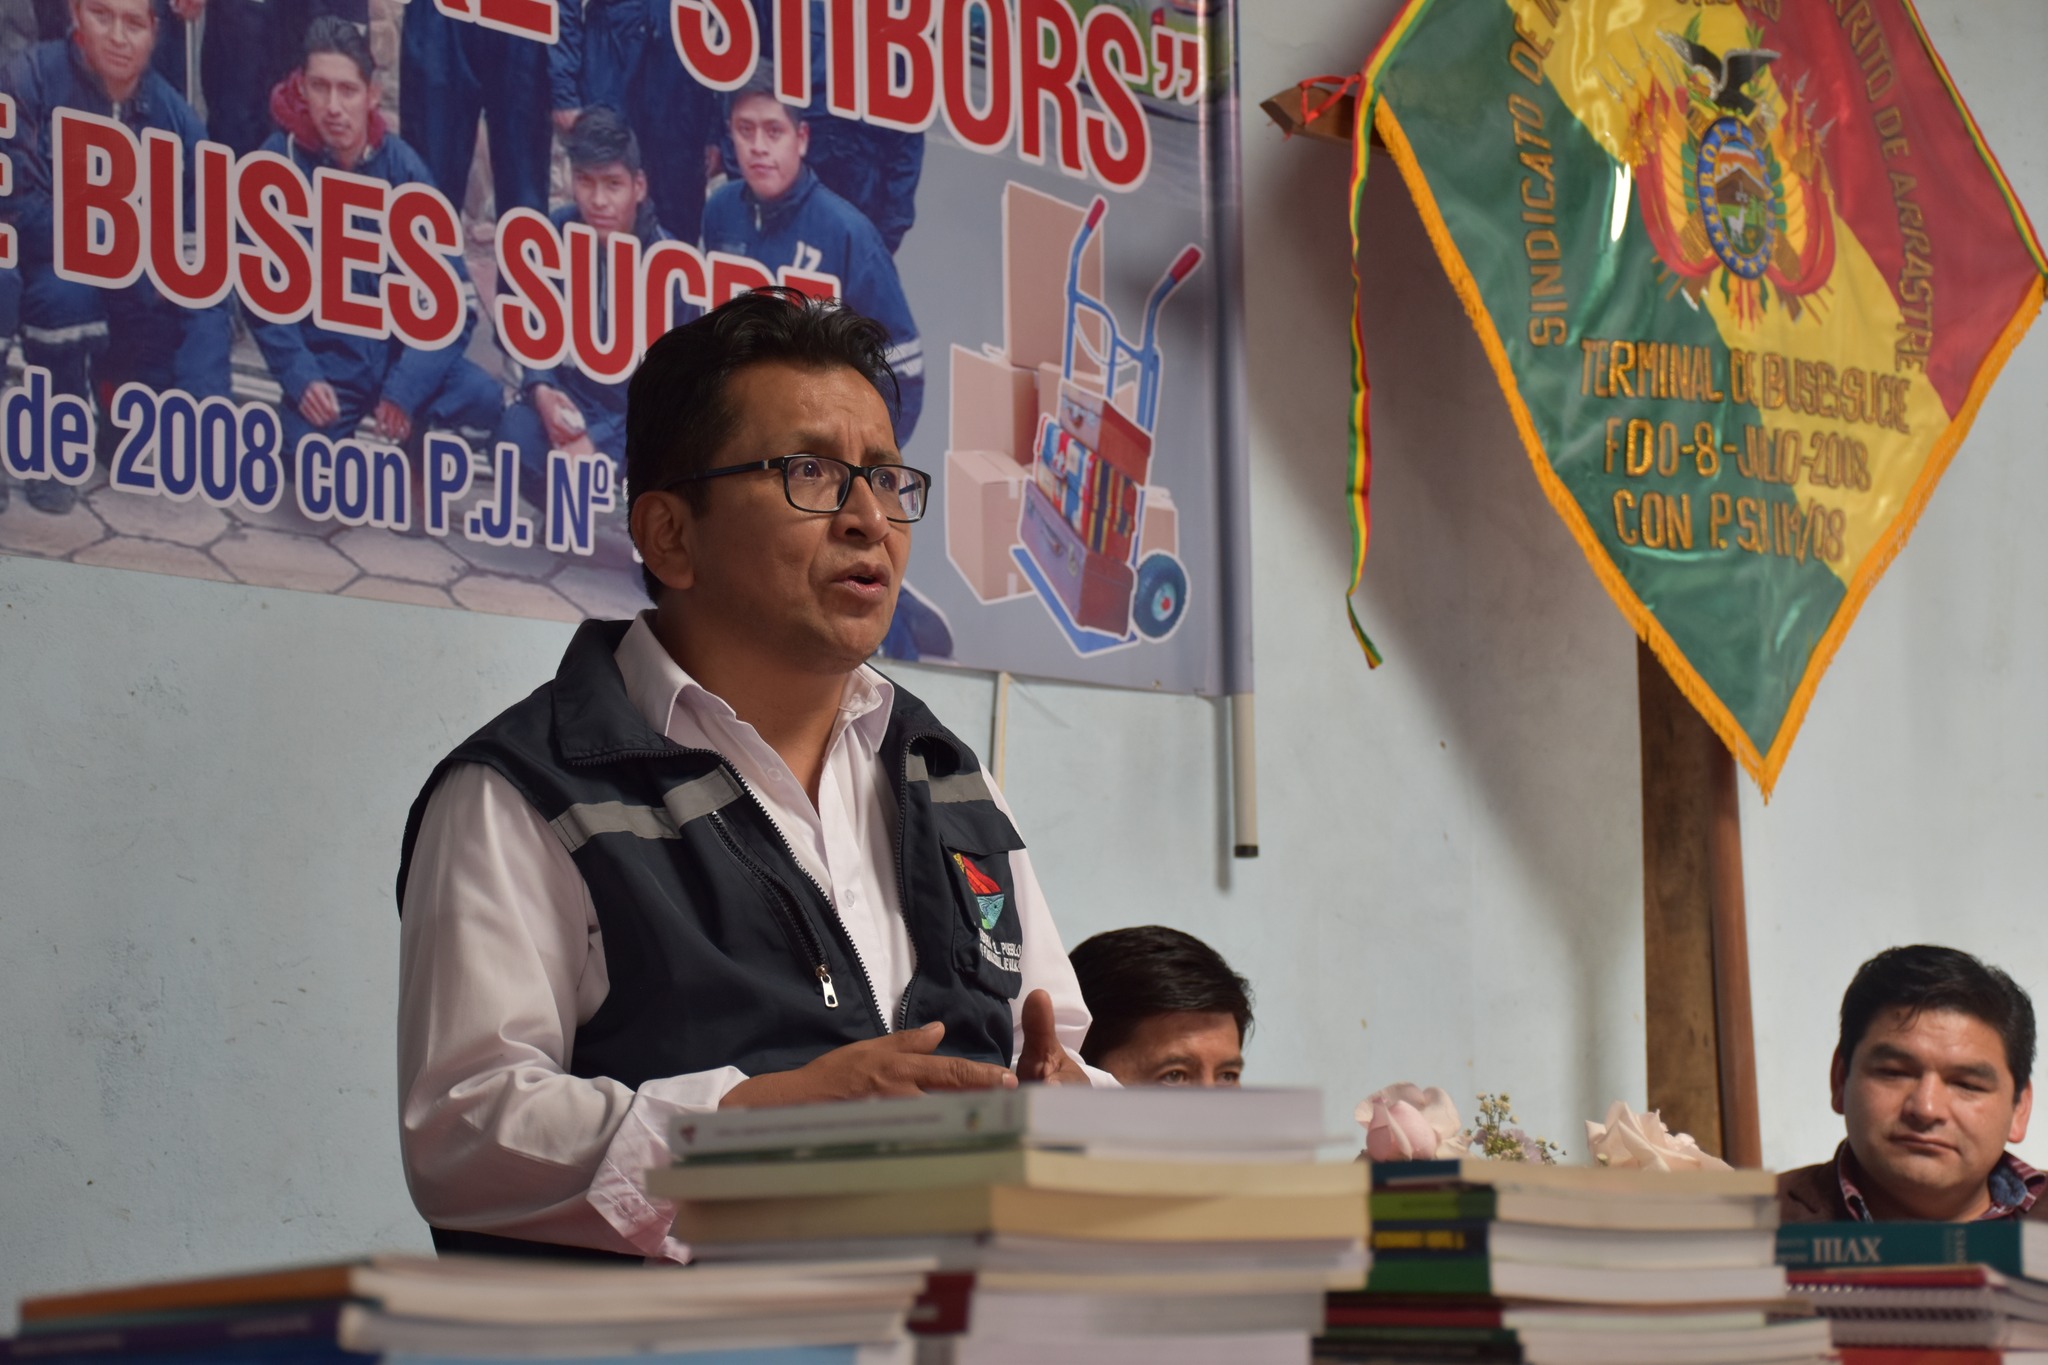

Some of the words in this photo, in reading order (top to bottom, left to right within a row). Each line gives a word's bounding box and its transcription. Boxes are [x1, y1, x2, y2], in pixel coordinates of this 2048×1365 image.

[1508, 12, 1554, 86] DE
[1872, 106, 1909, 159] DE
[52, 106, 466, 350] BUSES
[495, 207, 841, 384] SUC
[1507, 93, 1568, 347] SINDICATO
[1887, 170, 1933, 374] ARRASTRE
[1581, 339, 1724, 403] TERMINAL
[4, 365, 97, 485] de
[110, 381, 285, 512] 2008
[295, 433, 408, 532] con
[424, 432, 532, 549] P.J.
[546, 451, 615, 556] Nº
[1613, 489, 1693, 550] CON
[1812, 1237, 1883, 1263] XVIII
